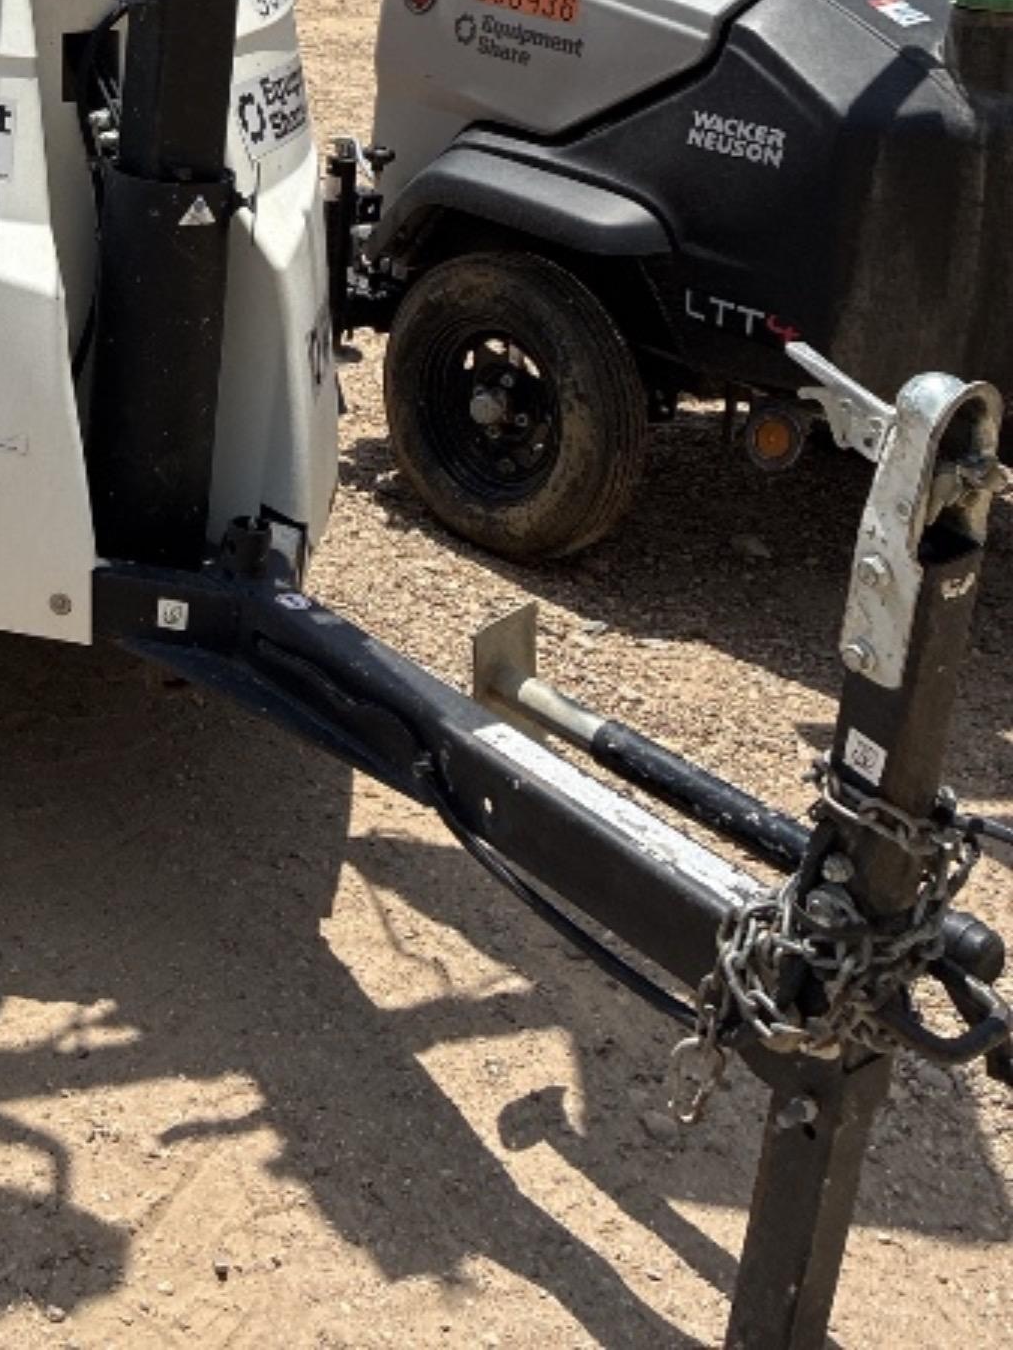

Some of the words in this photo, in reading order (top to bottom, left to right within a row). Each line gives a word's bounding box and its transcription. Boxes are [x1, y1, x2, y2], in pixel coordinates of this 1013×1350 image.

[477, 35, 532, 66] Share
[481, 14, 585, 58] Equipment
[686, 128, 784, 169] NEUSON
[692, 110, 786, 148] WACKER
